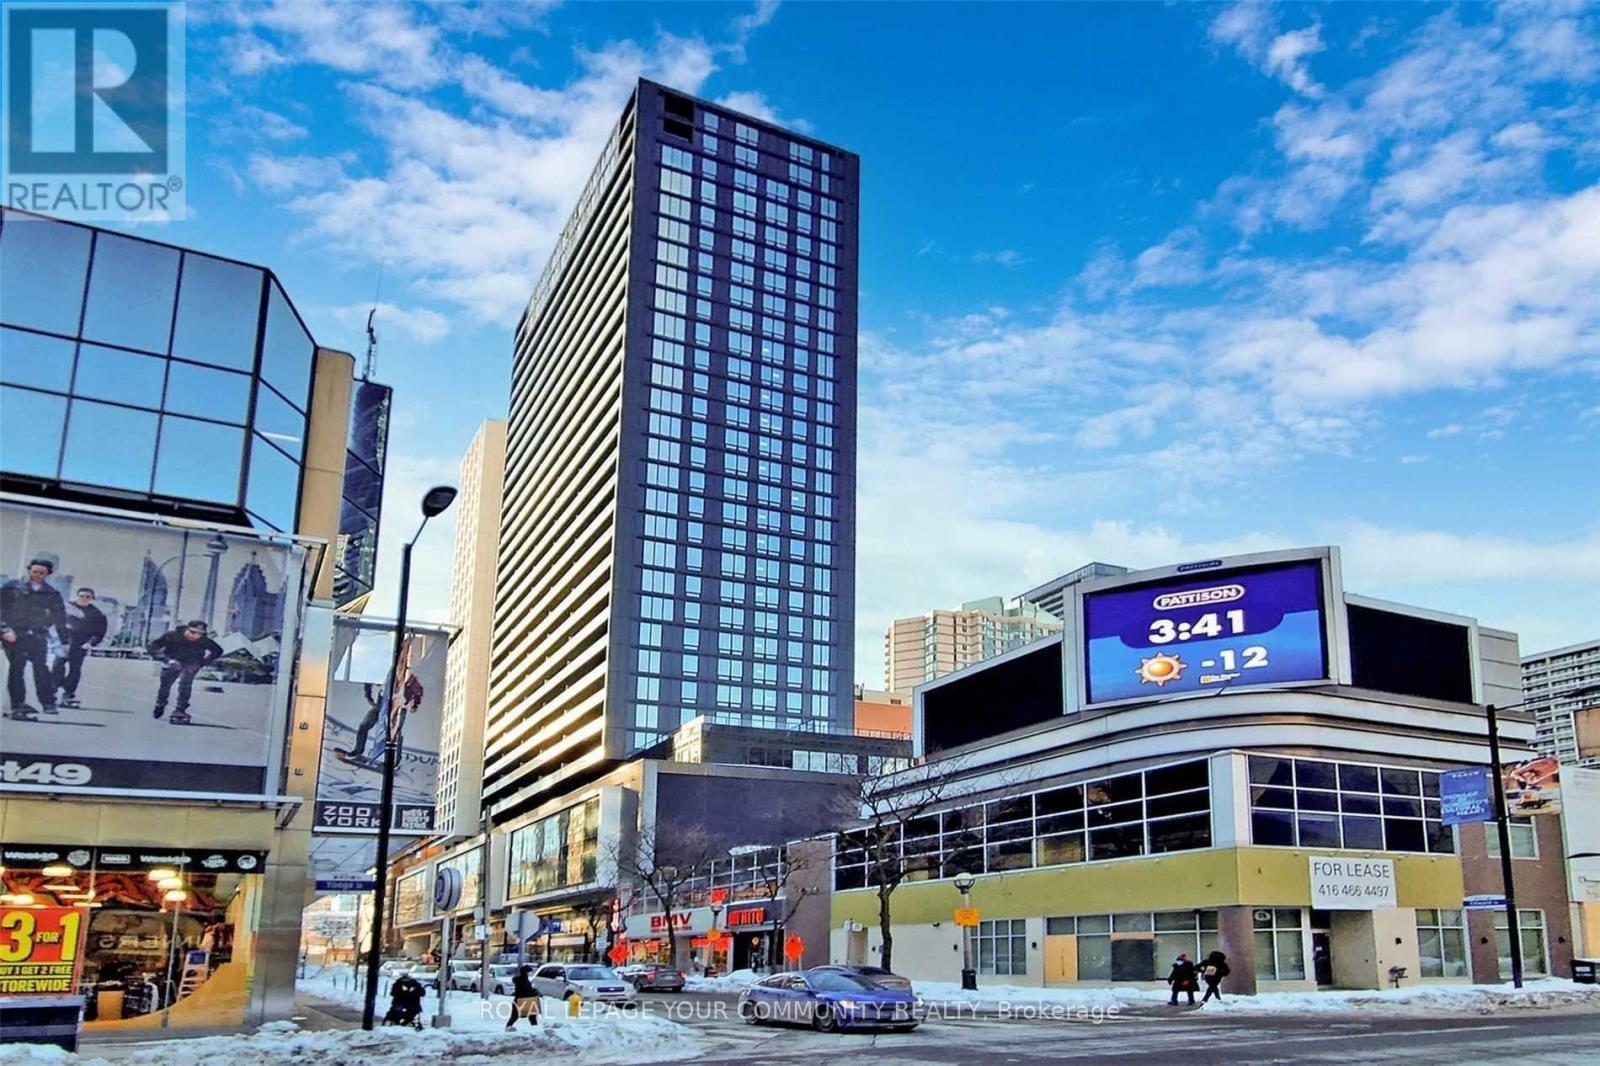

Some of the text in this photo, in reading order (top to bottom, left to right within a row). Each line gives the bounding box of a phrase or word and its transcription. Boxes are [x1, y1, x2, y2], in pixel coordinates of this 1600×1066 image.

[1160, 587, 1238, 607] PATTISON
[1148, 609, 1245, 644] 3:41
[1201, 646, 1268, 671] -12
[323, 806, 371, 816] ZOO
[322, 816, 381, 827] YORK
[1314, 863, 1390, 878] FOR LEASE
[1319, 884, 1339, 896] 416
[651, 912, 692, 927] BMV
[0, 911, 80, 962] 3 FOR 1
[21, 966, 39, 974] GET
[41, 966, 48, 974] 2
[50, 966, 72, 974] FREE
[0, 980, 70, 992] TOREWIDE
